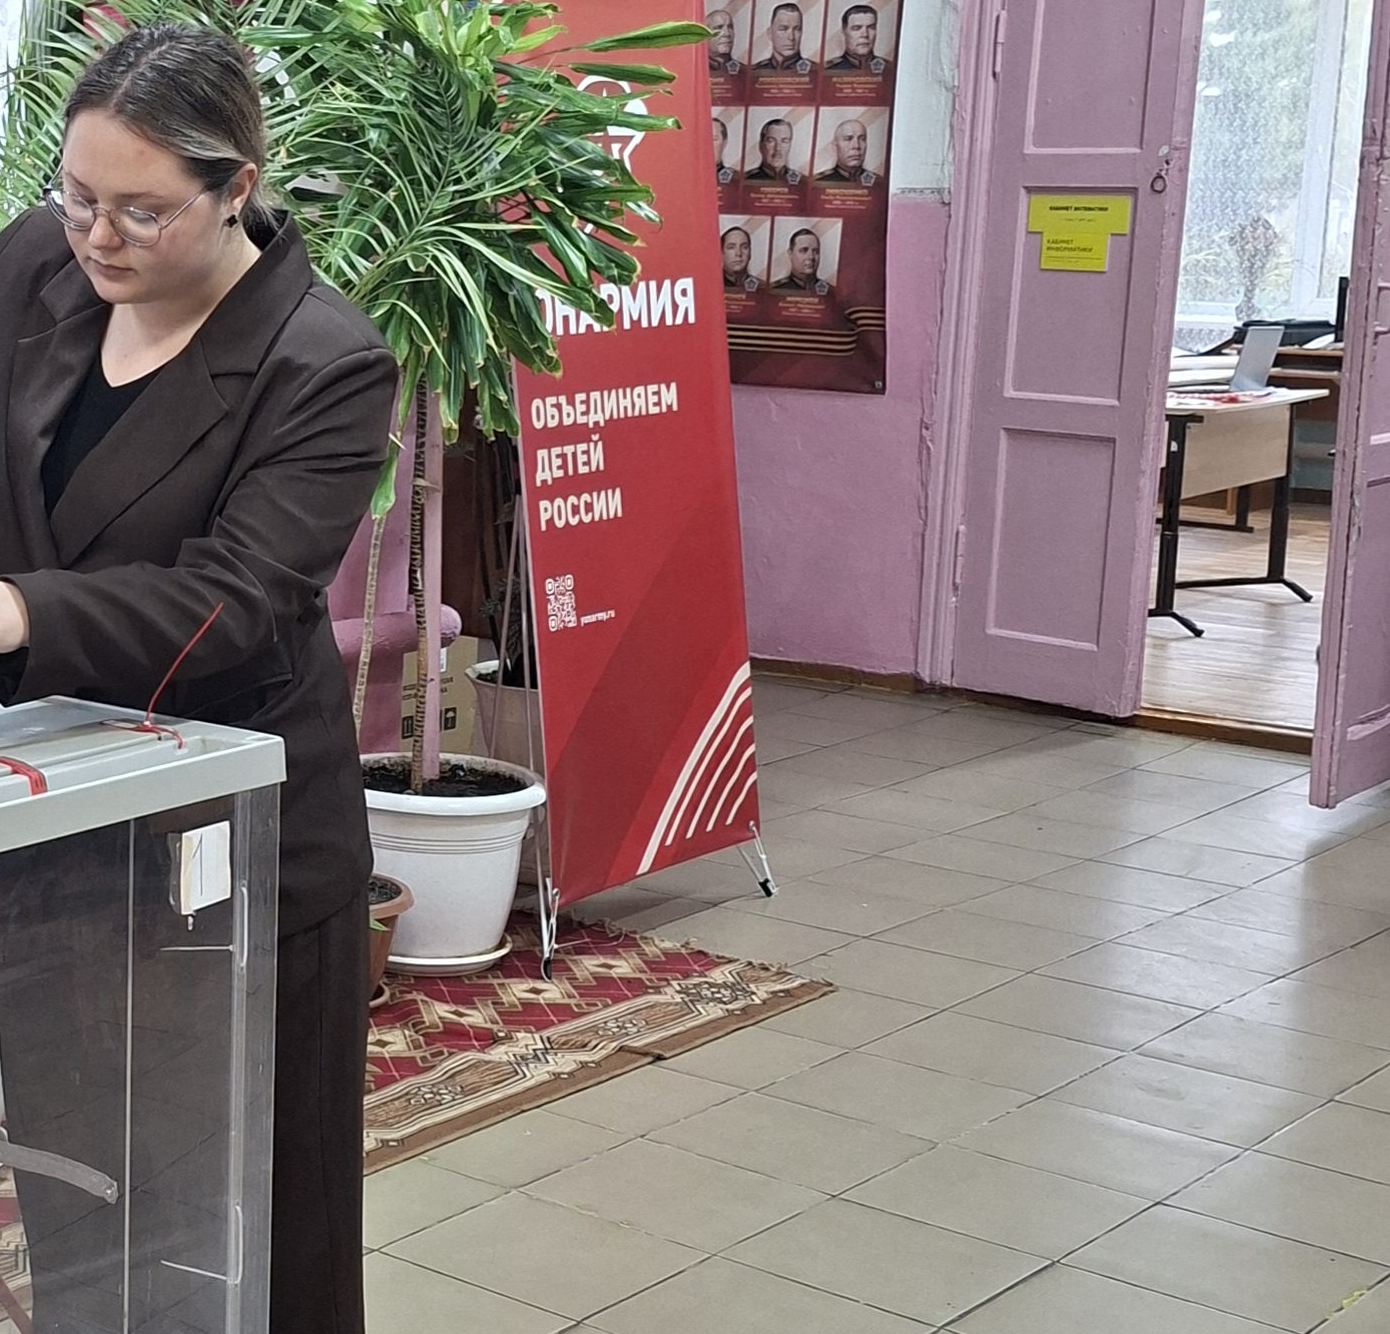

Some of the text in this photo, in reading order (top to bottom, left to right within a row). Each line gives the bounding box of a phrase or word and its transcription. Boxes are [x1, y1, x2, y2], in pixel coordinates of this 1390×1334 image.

[535, 277, 696, 336] НАРМИЯ
[531, 382, 678, 429] ОБЪЕДИНЯЕМ
[535, 433, 605, 487] ДЕТЕЙ
[539, 487, 623, 531] РОССИИ
[192, 833, 203, 897] 1
